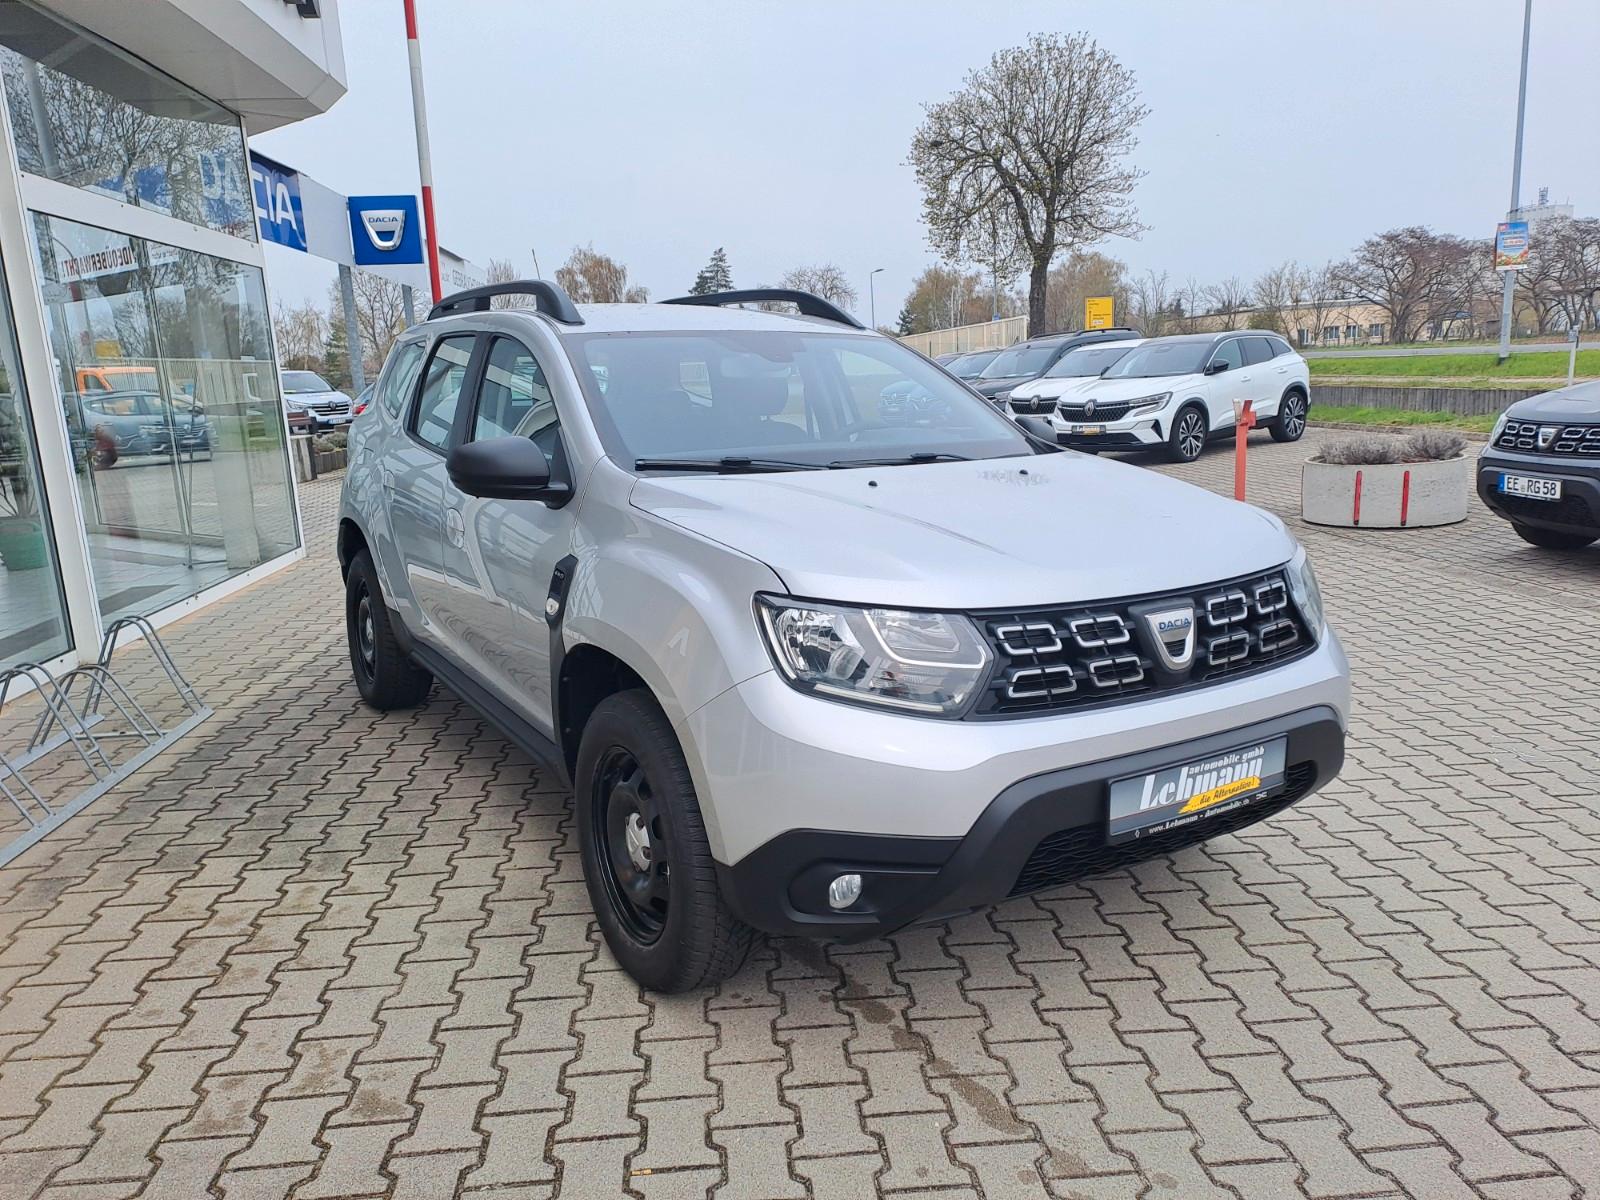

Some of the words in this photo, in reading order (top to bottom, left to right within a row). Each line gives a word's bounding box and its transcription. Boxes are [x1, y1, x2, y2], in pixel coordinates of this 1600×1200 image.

[1507, 477, 1519, 491] EE
[1159, 618, 1191, 630] DACIA
[1188, 755, 1240, 775] automobile
[1140, 758, 1263, 810] Lehmann
